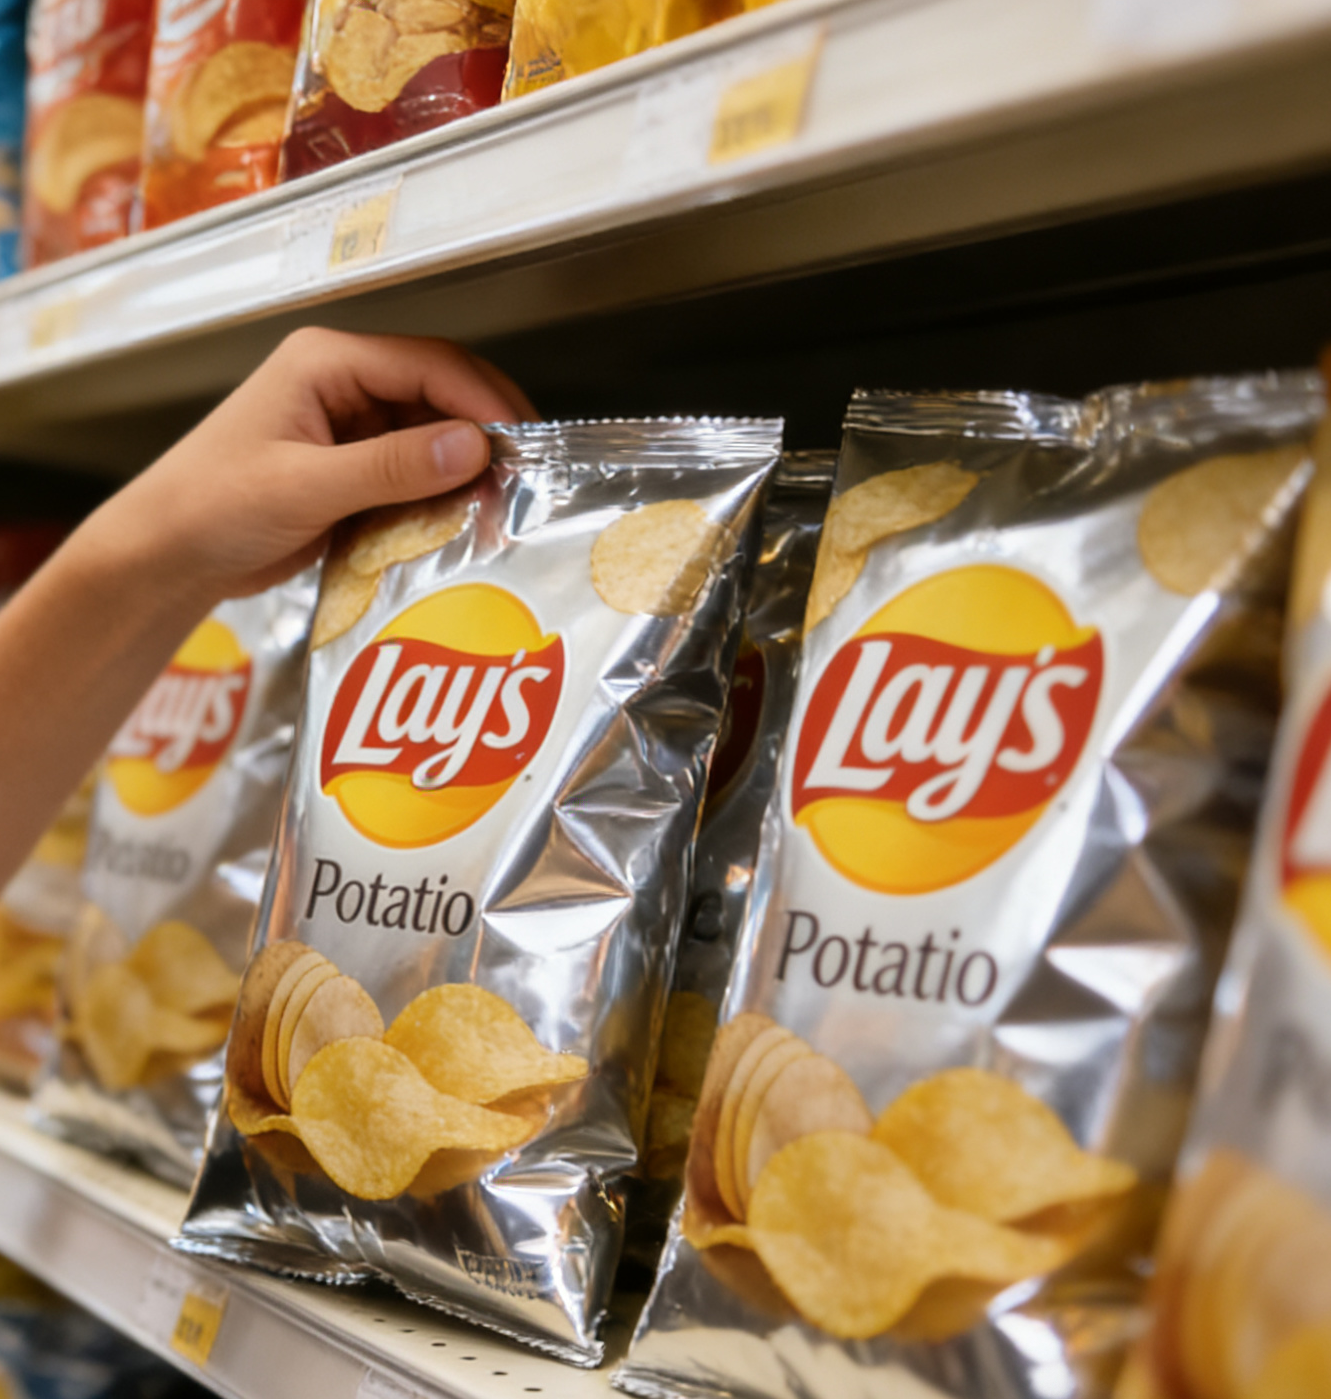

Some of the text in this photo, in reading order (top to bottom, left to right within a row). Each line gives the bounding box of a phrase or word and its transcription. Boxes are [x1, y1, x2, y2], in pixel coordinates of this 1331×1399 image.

[332, 643, 551, 789] Lay's
[803, 641, 1088, 821] Lay's
[305, 858, 475, 938] Potatio
[774, 910, 999, 1008] Potatio
